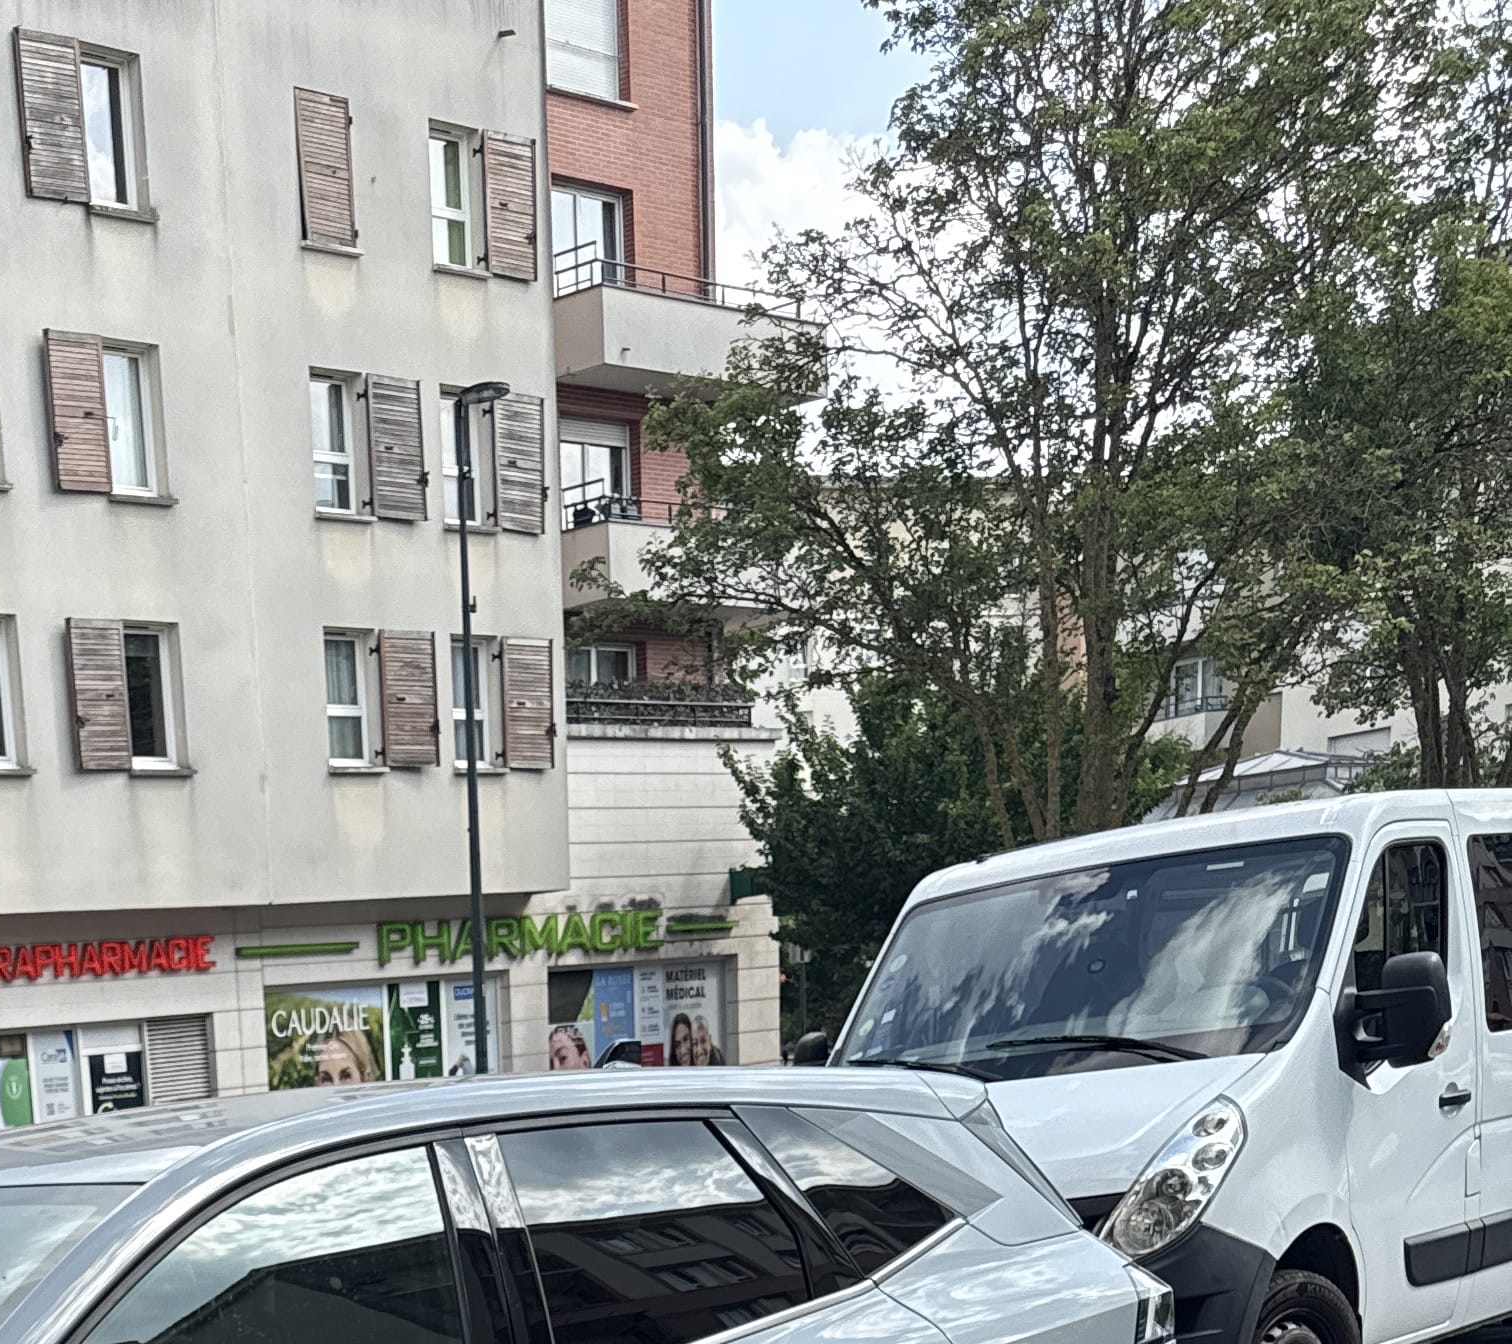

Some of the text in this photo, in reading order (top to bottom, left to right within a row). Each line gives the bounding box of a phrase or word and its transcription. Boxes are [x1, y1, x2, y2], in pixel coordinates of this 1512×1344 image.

[376, 908, 664, 969] PHARMACIE
[665, 984, 706, 1000] MÉDICAL
[271, 1000, 371, 1038] CAUDALIE
